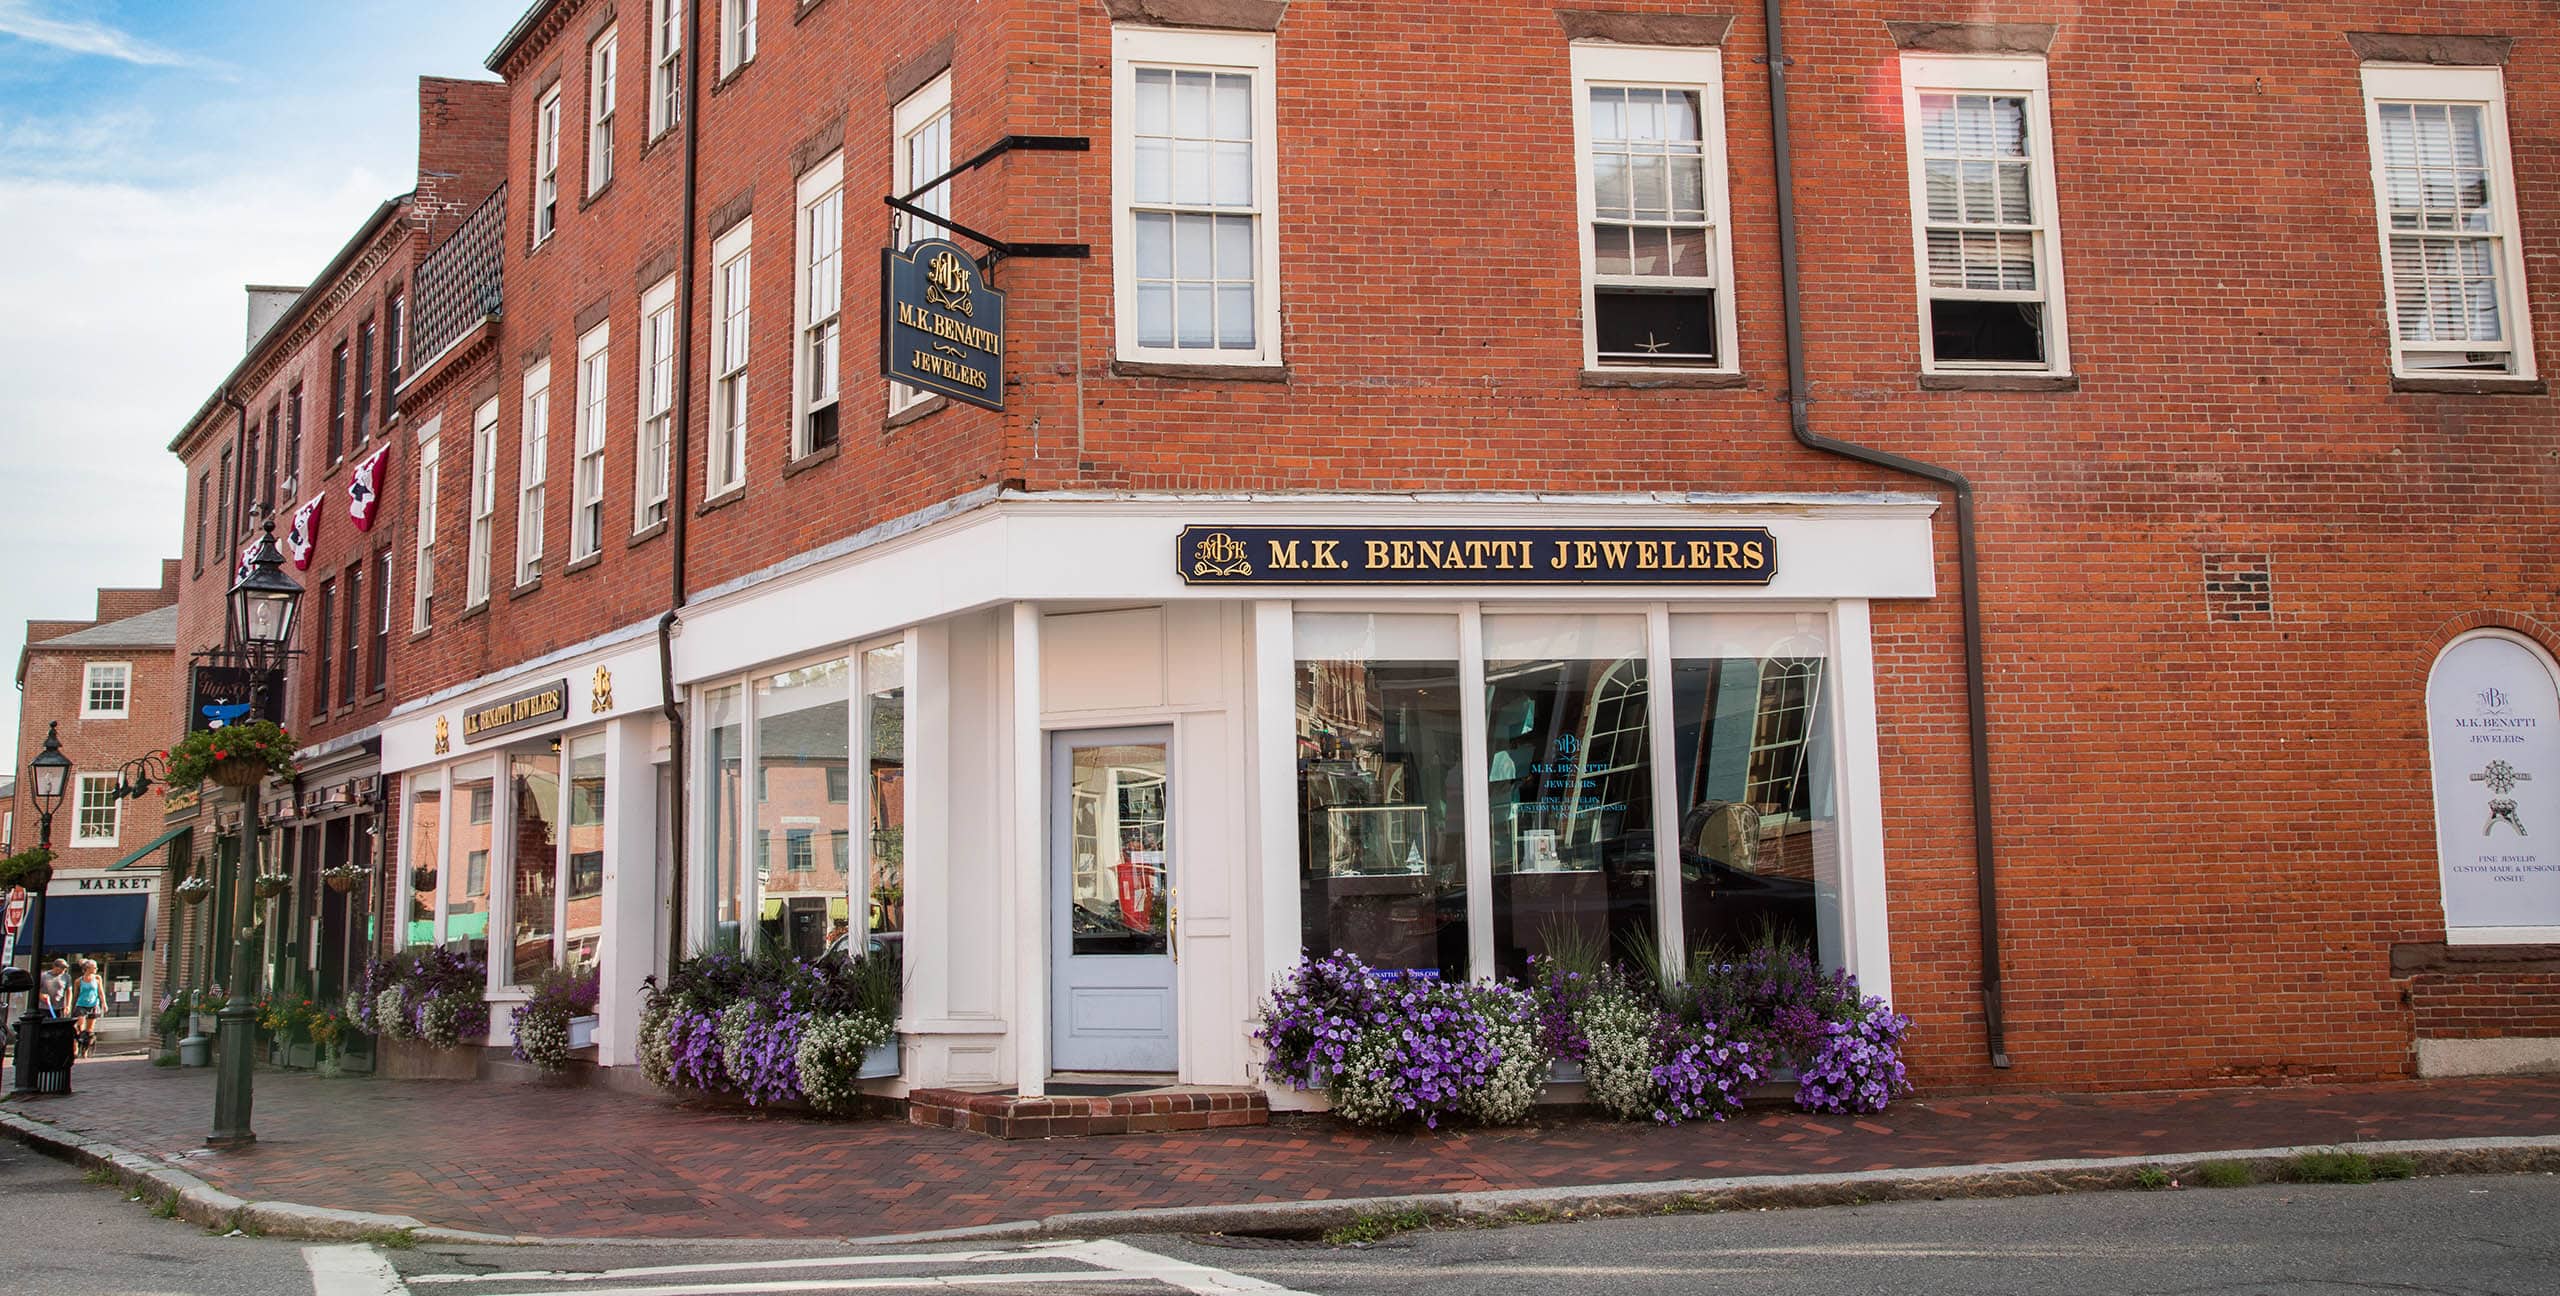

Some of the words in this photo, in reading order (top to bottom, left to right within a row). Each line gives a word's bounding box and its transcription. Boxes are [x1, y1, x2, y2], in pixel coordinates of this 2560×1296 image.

[899, 301, 932, 332] M.K.
[933, 313, 1000, 355] BENATTI
[912, 350, 987, 389] JEWELERS
[1268, 540, 1349, 569] M.K.
[1365, 541, 1533, 569] BENATTI
[1552, 541, 1764, 570] JEWELERS
[480, 703, 512, 730] BENATTI
[514, 690, 559, 722] JEWELERS
[2456, 718, 2481, 727] M.K.
[2484, 718, 2536, 727] BENATTI
[2470, 735, 2525, 743] JEWELERS
[2501, 855, 2536, 863] JEWELRY
[80, 879, 151, 889] MARKET
